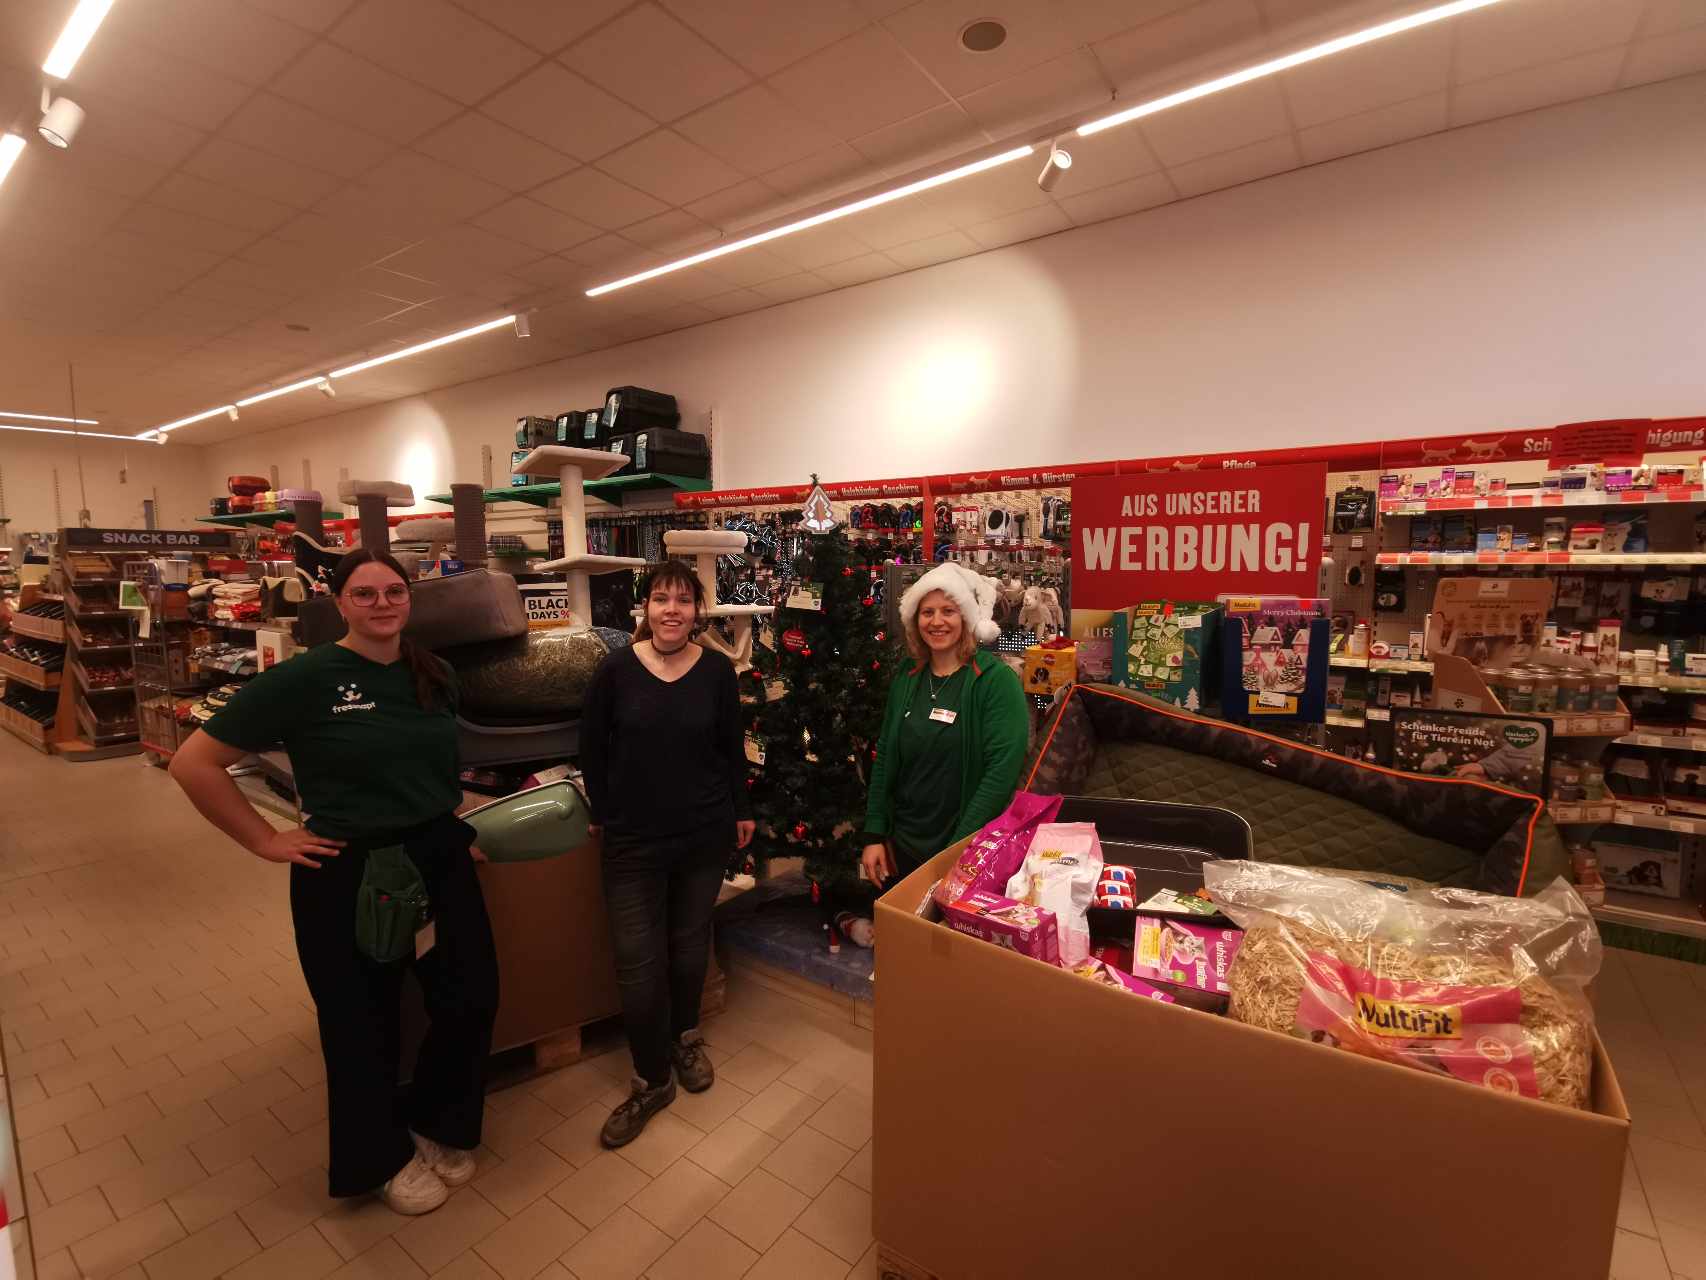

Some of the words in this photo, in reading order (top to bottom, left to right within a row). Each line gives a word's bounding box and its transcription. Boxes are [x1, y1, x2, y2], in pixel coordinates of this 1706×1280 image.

[1121, 494, 1158, 517] AUS
[1165, 489, 1261, 516] UNSERER
[101, 532, 163, 545] SNACK
[165, 534, 200, 545] BAR
[1082, 522, 1310, 572] WERBUNG!
[1400, 720, 1447, 734] Schenke
[1446, 725, 1487, 737] Freude
[1411, 730, 1429, 741] für
[1430, 733, 1459, 743] Tiere
[1472, 737, 1496, 747] Not
[1215, 941, 1229, 980] whiskas
[1359, 996, 1454, 1036] MultiFit
